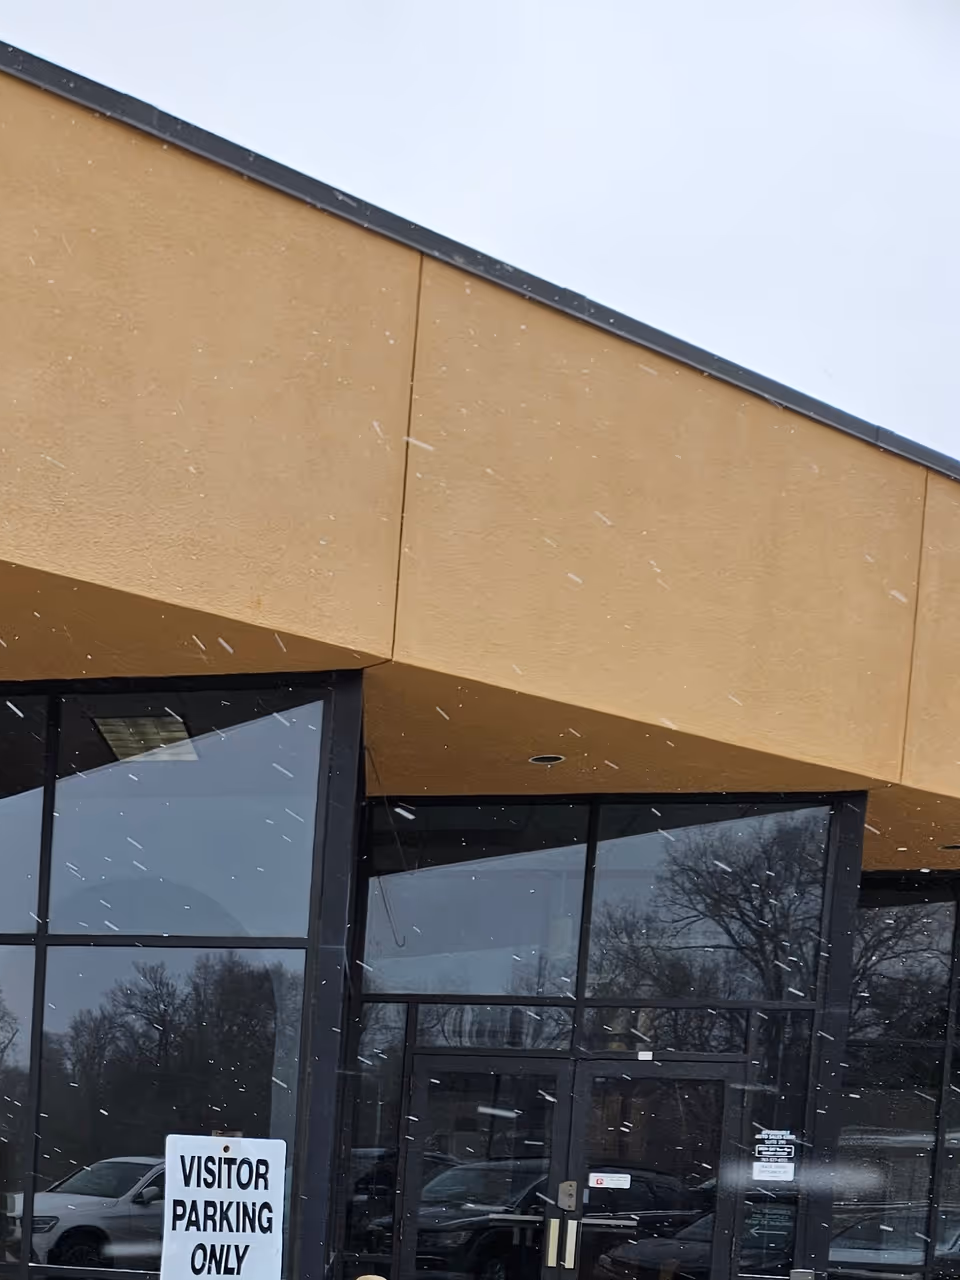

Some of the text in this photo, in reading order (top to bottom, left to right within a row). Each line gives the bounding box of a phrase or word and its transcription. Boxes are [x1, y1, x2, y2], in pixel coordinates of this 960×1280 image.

[180, 1155, 270, 1190] VISITOR
[171, 1199, 273, 1234] PARKING
[191, 1243, 250, 1275] ONLY
